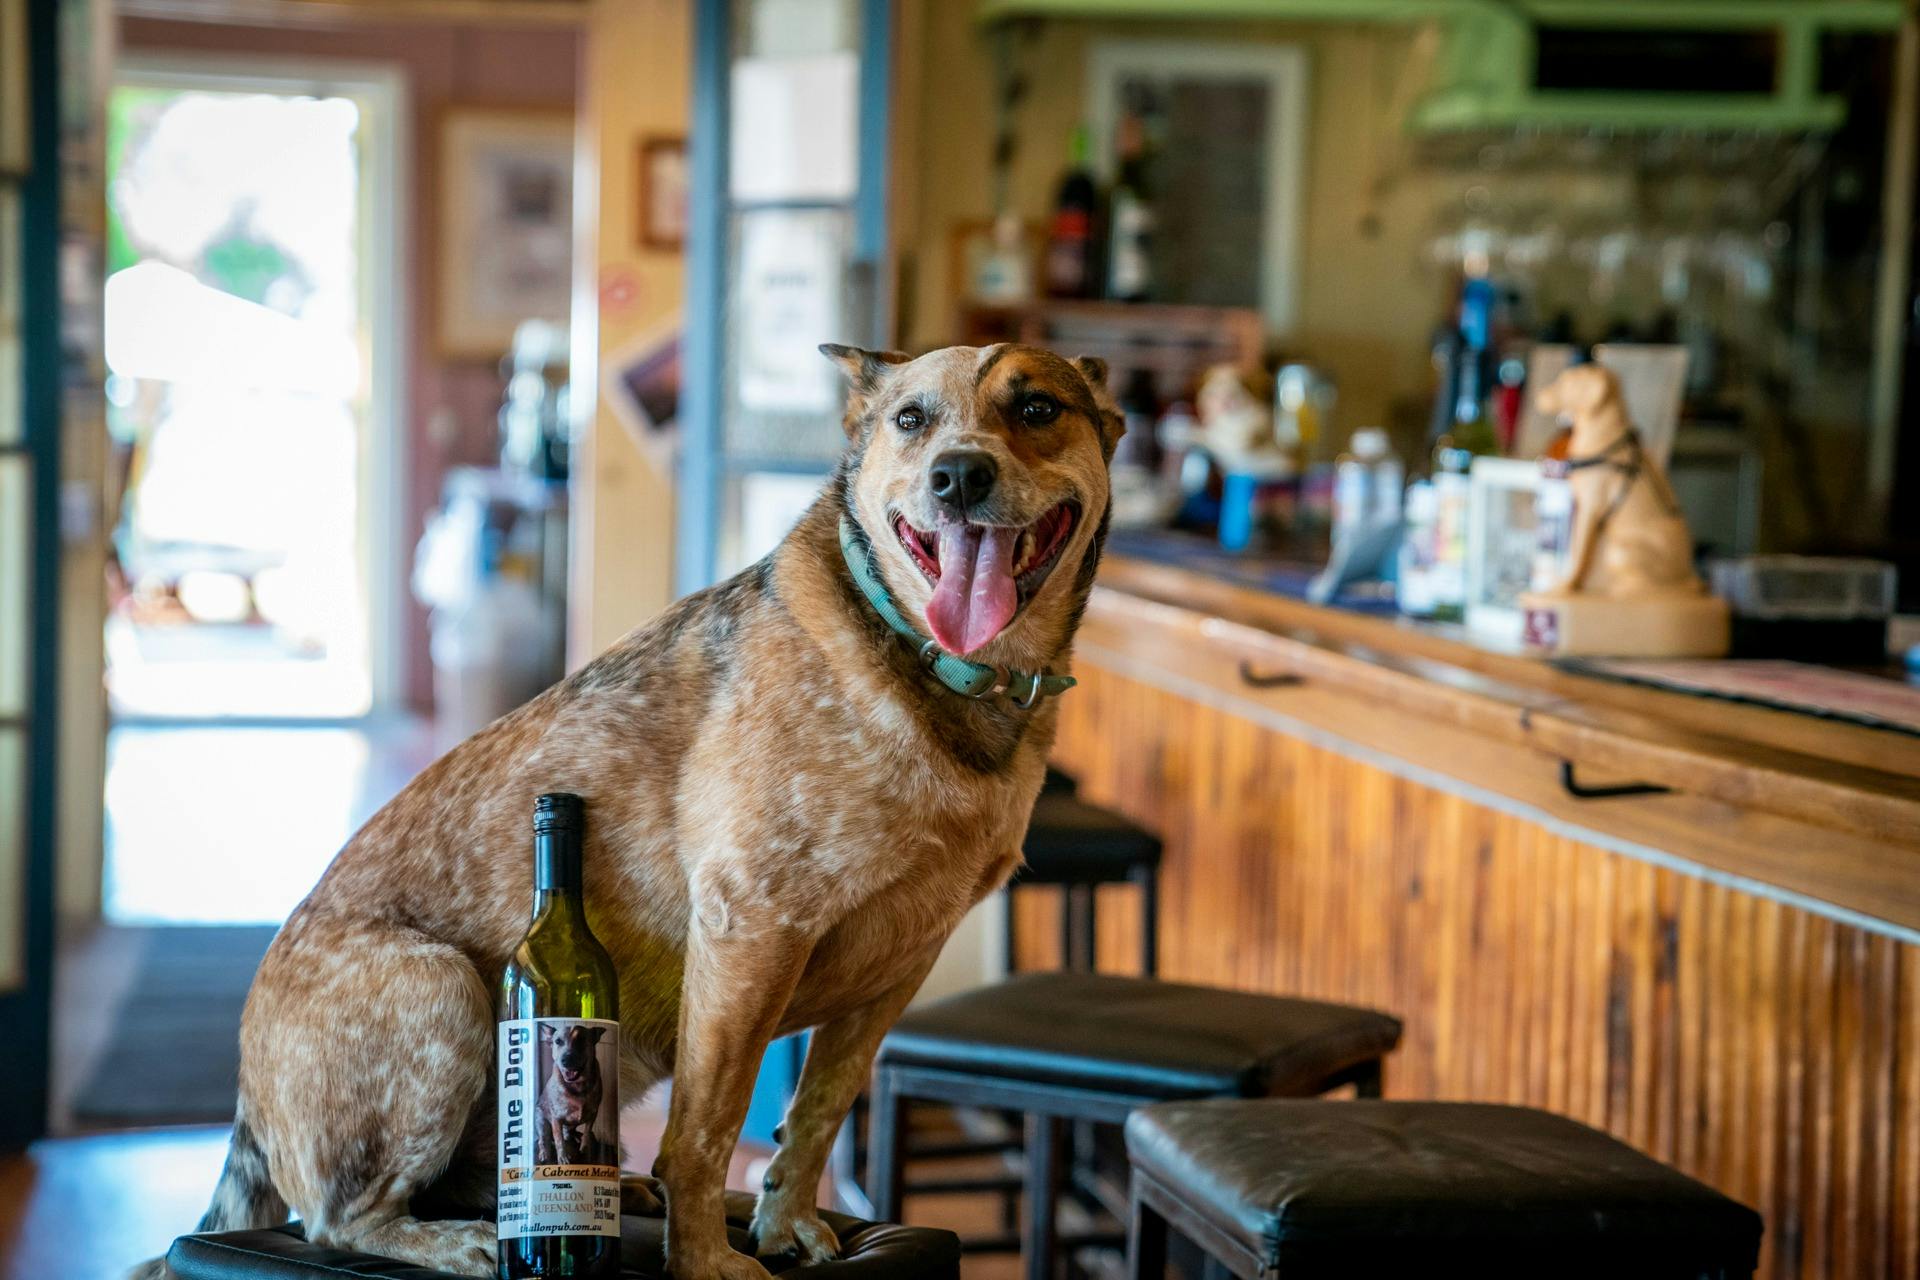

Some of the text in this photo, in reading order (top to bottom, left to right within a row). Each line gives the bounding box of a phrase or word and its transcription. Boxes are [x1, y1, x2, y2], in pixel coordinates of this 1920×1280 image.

[504, 1028, 529, 1163] The Dog
[542, 1166, 590, 1177] Cabernet
[591, 1167, 615, 1177] Merlot
[538, 1192, 584, 1202] THALLON
[532, 1204, 593, 1215] QUEENSLAND
[520, 1222, 602, 1234] thallonpub.com.au
